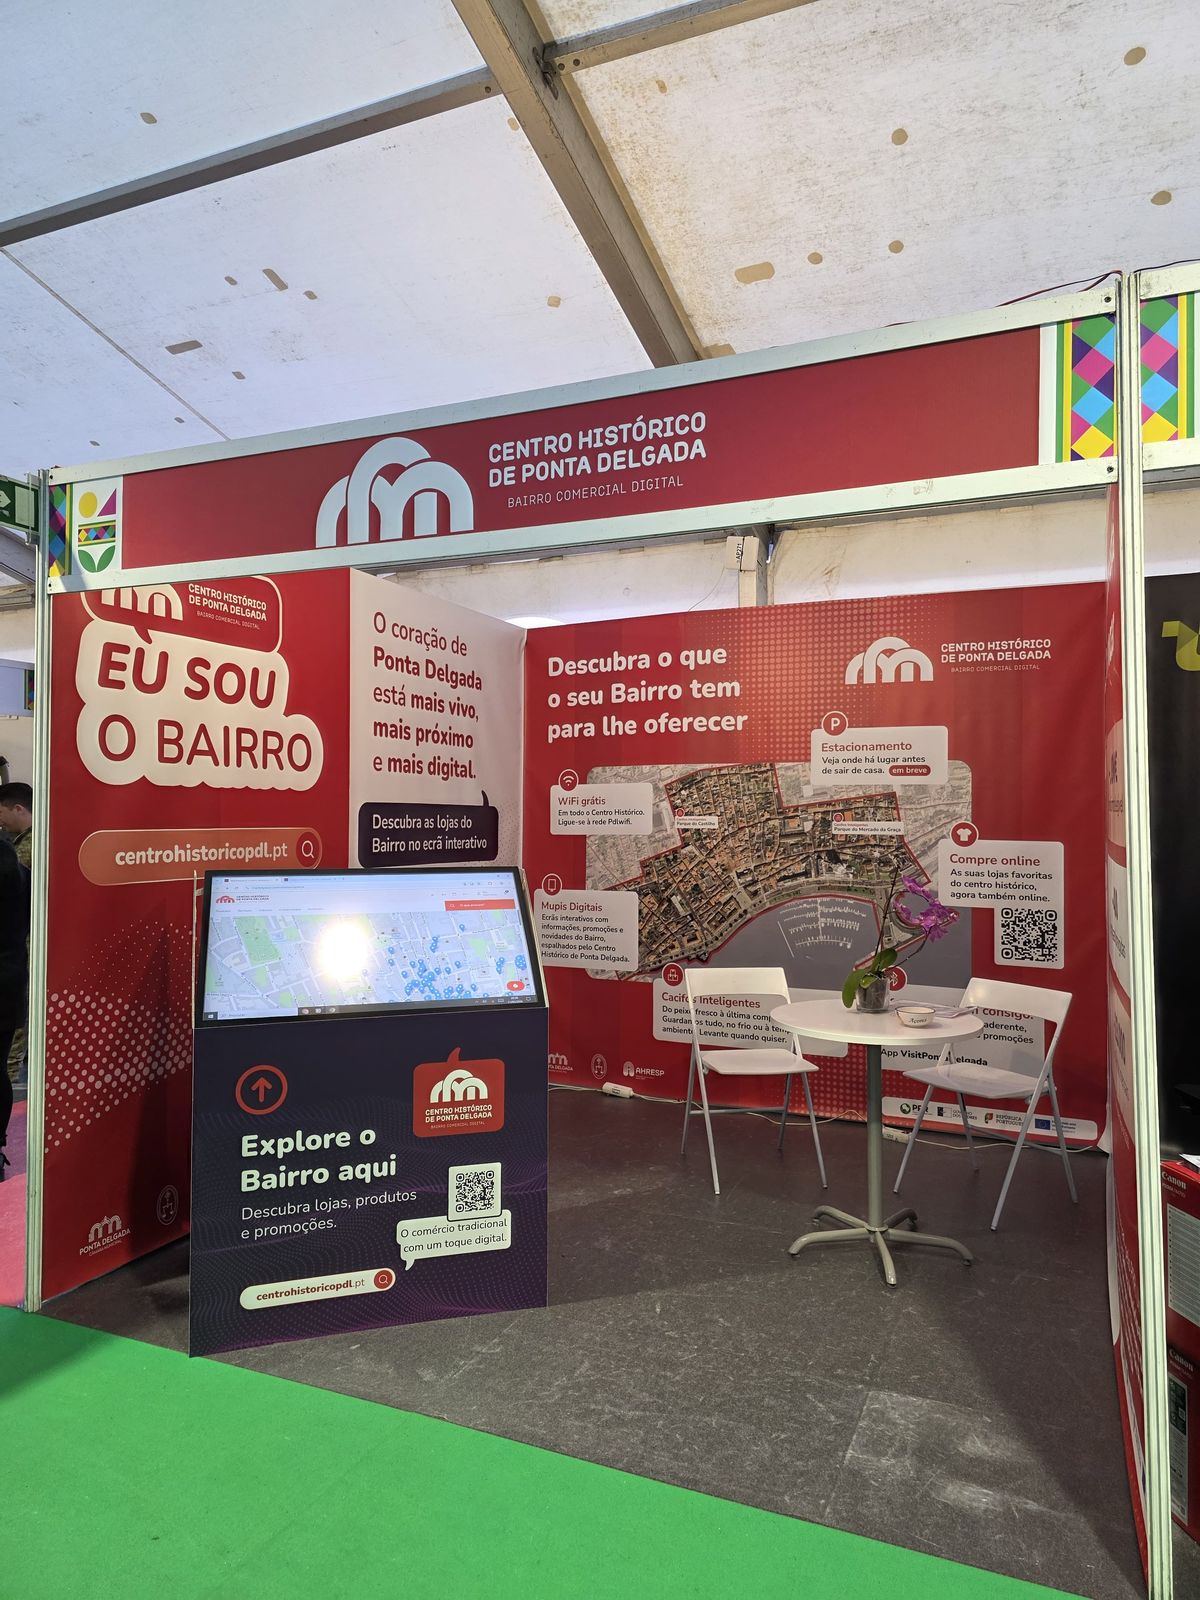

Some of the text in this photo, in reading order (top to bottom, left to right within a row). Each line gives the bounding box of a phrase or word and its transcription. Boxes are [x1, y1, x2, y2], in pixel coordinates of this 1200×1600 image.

[488, 411, 706, 464] CENTRO HISTÓRICO
[489, 438, 707, 488] DE PONTA DELGADA
[507, 475, 684, 508] BAIRRO COMERCIAL DIGITAL
[188, 583, 267, 611] CENTRO HISTÓRICO
[189, 594, 267, 621] DE PONTA DELGADA
[374, 612, 467, 656] O coração de
[941, 638, 1051, 652] CENTRO HISTÓRICO
[548, 648, 727, 677] Descubra o que
[941, 650, 1051, 663] DE PONTA DELGADA
[98, 642, 276, 709] EU SOU
[374, 646, 482, 691] Ponta Delgada
[548, 680, 740, 707] o seu Bairro tem
[374, 684, 479, 723] está mais vivo,
[374, 718, 473, 749] mais próximo
[548, 712, 748, 744] para lhe oferecer
[98, 714, 312, 772] O BAIRRO
[821, 742, 912, 752] Estacionamento
[373, 753, 476, 781] e mais digital.
[822, 756, 839, 765] Veja
[842, 756, 862, 764] onde
[865, 755, 875, 764] há
[877, 755, 900, 765] lugar
[822, 766, 832, 774] de
[834, 766, 849, 774] sair
[851, 766, 862, 774] de
[906, 766, 928, 774] breve
[558, 797, 606, 807] WiFi grátis
[614, 808, 645, 816] Histórico.
[372, 814, 472, 831] Descubra as lojas do
[558, 819, 584, 827] Ligue-se
[372, 836, 487, 853] Bairro no ecrã interativo
[115, 842, 288, 865] centrohistoricopdl.pt
[950, 854, 1040, 867] Compre online
[987, 870, 1009, 879] lojas
[1011, 871, 1053, 880] favoritas
[995, 881, 1037, 891] histórico,
[978, 891, 1016, 901] também
[1018, 894, 1050, 902] online.
[542, 902, 603, 912] Mupis Digitais
[583, 925, 618, 933] promoções
[585, 934, 606, 943] Bairro,
[541, 942, 577, 951] espalhados
[579, 944, 593, 952] pelo
[541, 951, 569, 959] Histórico
[580, 953, 599, 961] Ponta
[601, 954, 630, 963] Delgada.
[700, 996, 760, 1009] Inteligentes
[696, 1008, 718, 1017] fresco
[727, 1010, 750, 1019] última
[705, 1020, 724, 1028] tudo,
[738, 1022, 751, 1030] frio
[700, 1028, 728, 1038] Levante
[762, 1035, 787, 1043] quiser.
[984, 1034, 1034, 1044] promoções
[881, 1049, 898, 1057] App
[636, 1068, 665, 1077] AHRESP
[425, 1104, 492, 1116] CENTRO HISTÓRICO
[436, 1114, 459, 1122] PONTA
[460, 1112, 492, 1120] DELGADA
[241, 1129, 376, 1159] Explore o
[241, 1154, 397, 1192] Bairro aqui
[1162, 1171, 1186, 1189] Canon
[242, 1190, 417, 1221] Descubra lojas, produtos
[241, 1218, 337, 1240] e promoções.
[400, 1218, 508, 1238] O comércio tradicional
[80, 1241, 101, 1256] PONTA
[102, 1228, 131, 1245] DELGADA
[404, 1234, 507, 1253] com um toque digital.
[256, 1278, 365, 1301] centrohistoricopdl.pt
